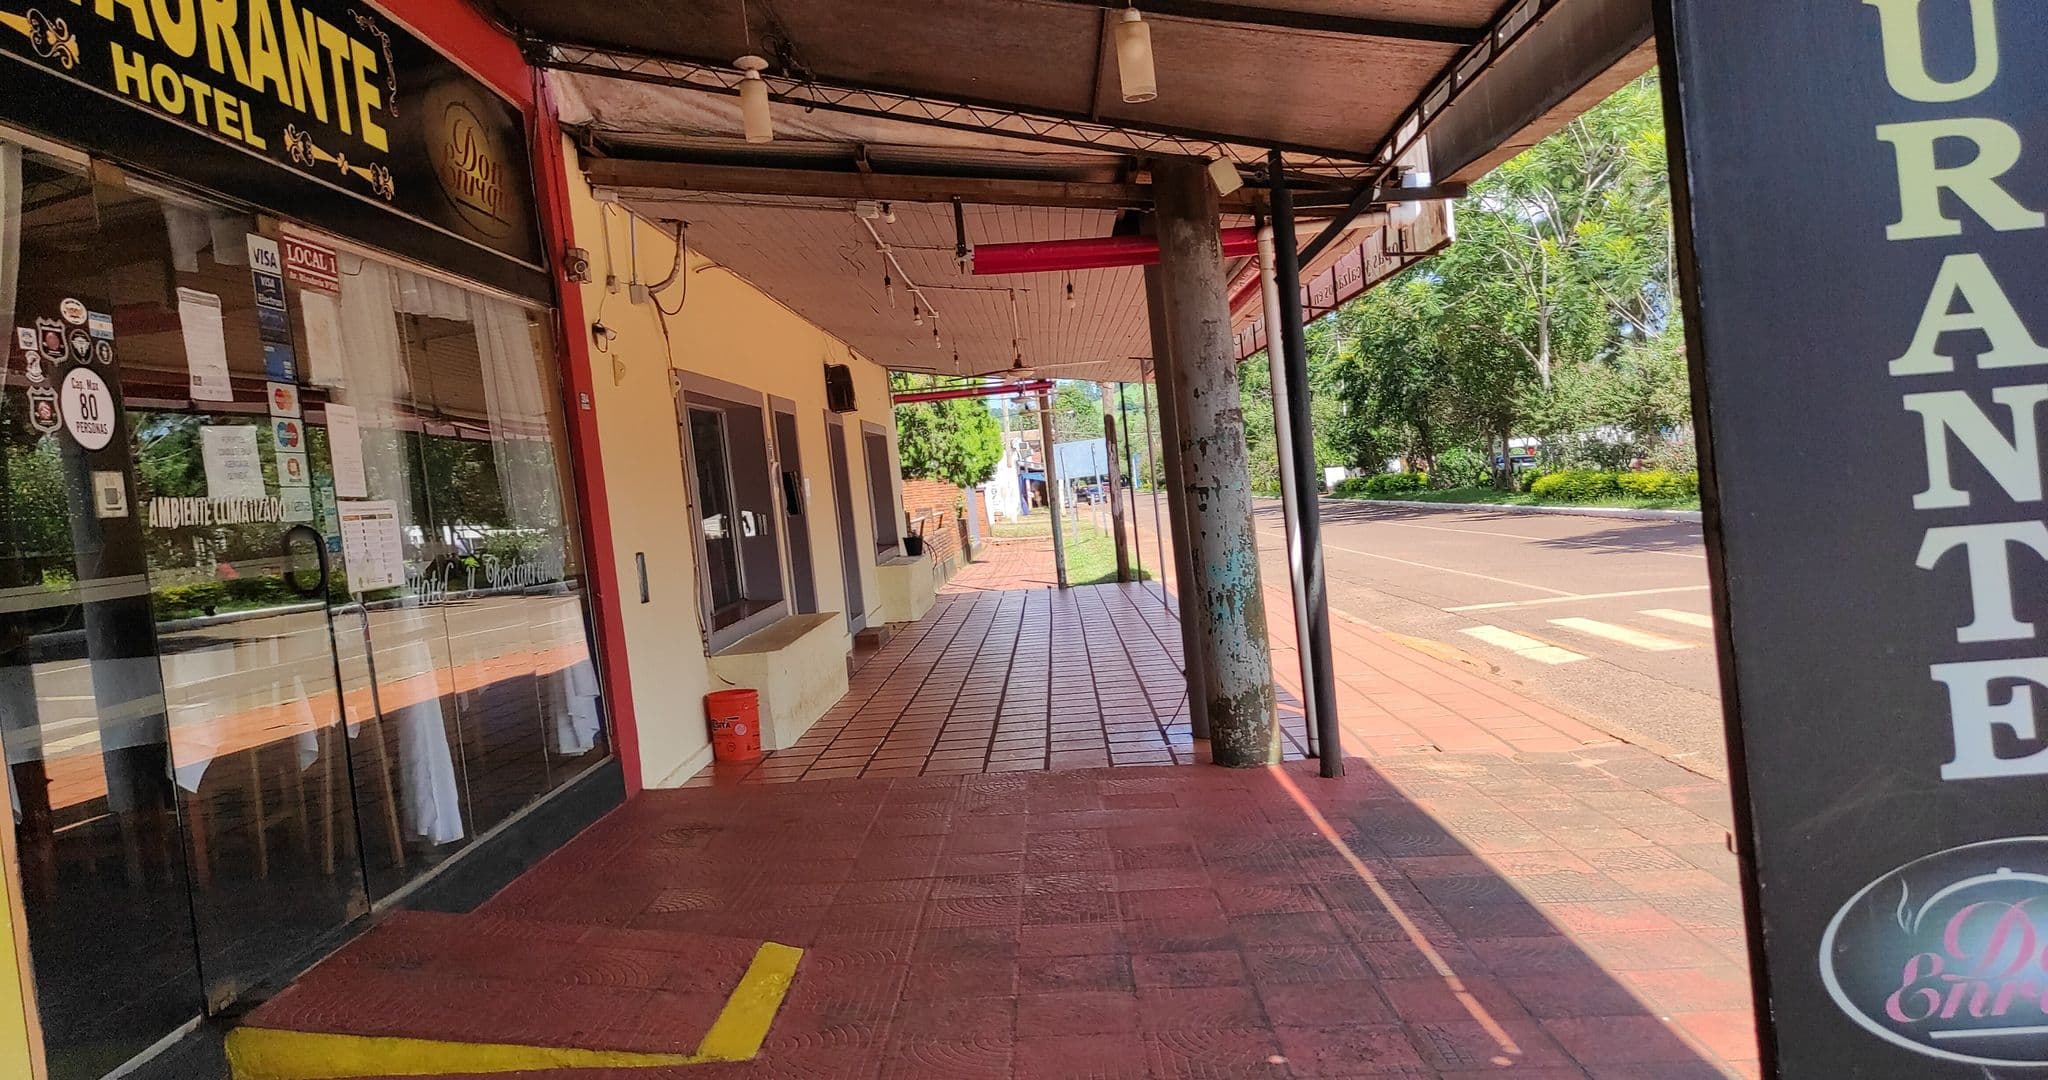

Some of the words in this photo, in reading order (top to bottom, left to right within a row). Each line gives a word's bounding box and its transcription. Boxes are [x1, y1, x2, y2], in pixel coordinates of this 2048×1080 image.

[110, 41, 266, 150] HOTEL
[453, 118, 504, 187] Don
[254, 248, 278, 269] VISA
[286, 243, 327, 271] LOCAL
[328, 257, 338, 274] 1
[260, 276, 276, 289] VISA
[79, 392, 98, 421] 80
[75, 421, 109, 435] PERSONAS
[149, 496, 212, 530] AMBIENTE
[213, 496, 286, 524] CLIMATIZADO
[1941, 895, 2048, 980] D
